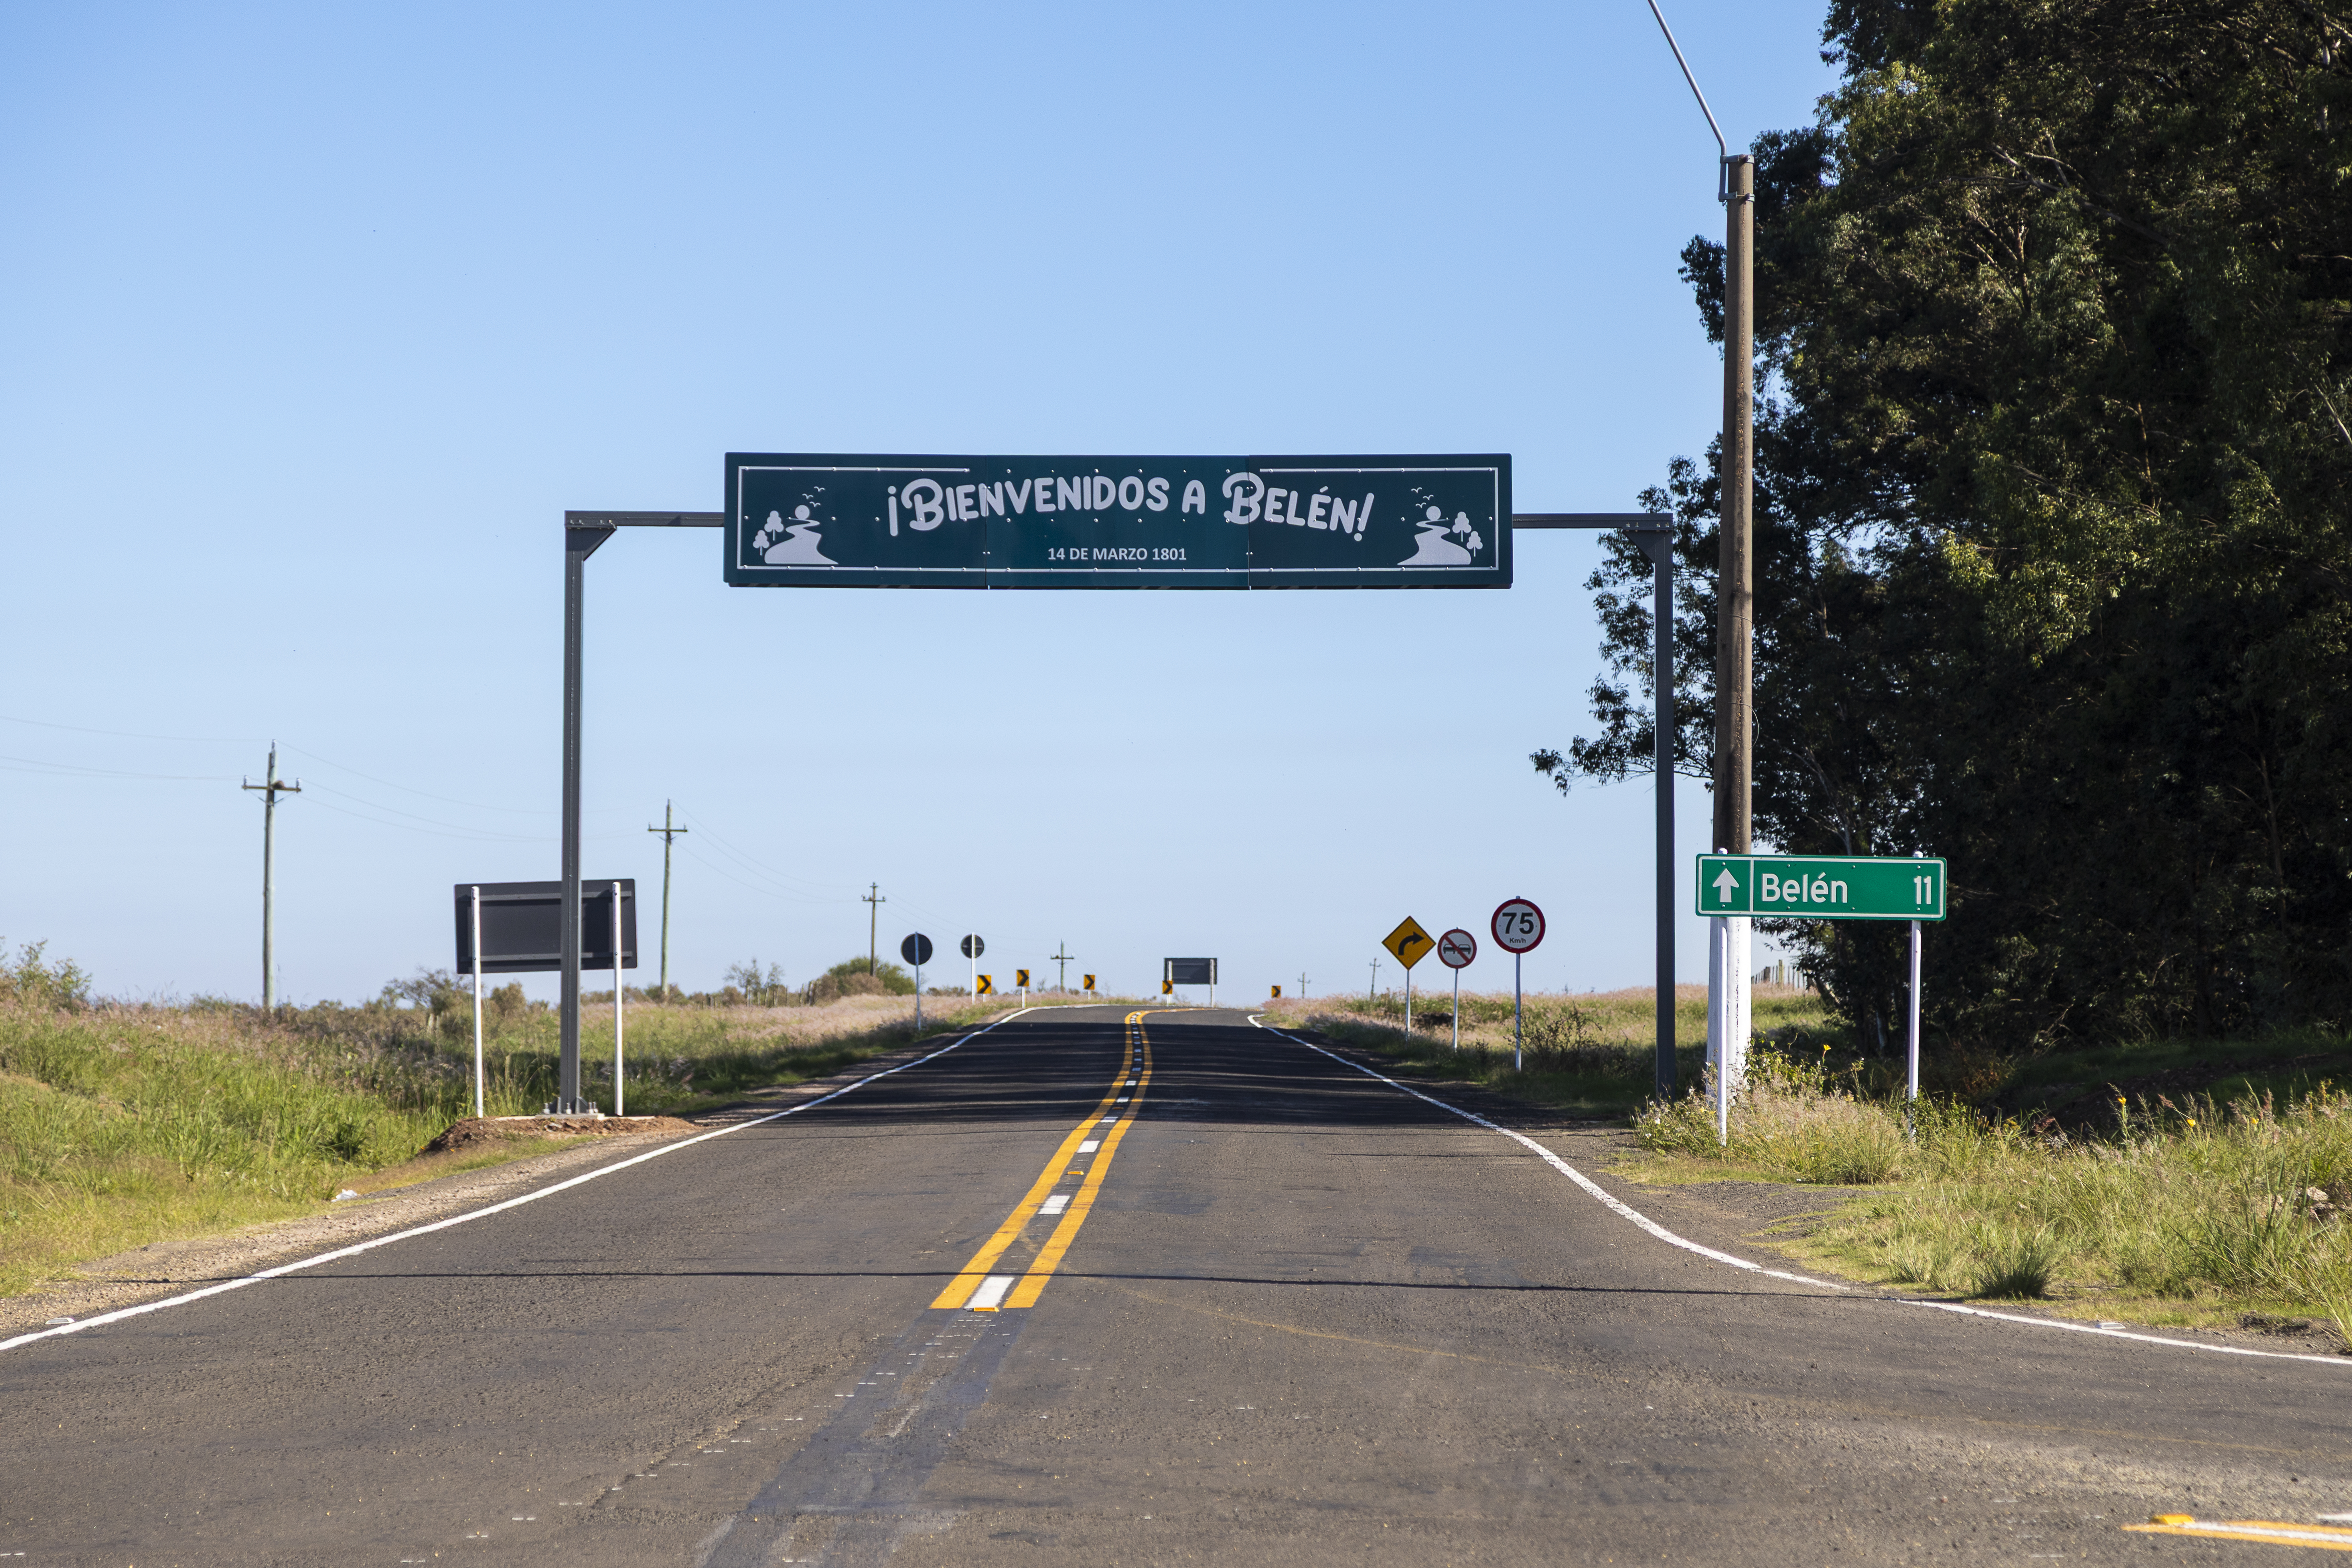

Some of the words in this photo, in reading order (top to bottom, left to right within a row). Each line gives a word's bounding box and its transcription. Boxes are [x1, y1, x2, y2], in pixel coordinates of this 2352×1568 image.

[888, 476, 1170, 536] ¡BIENVENIDOS
[1182, 479, 1206, 514] A
[1222, 472, 1374, 542] BELÉN!
[1048, 548, 1065, 560] 14
[1070, 548, 1088, 560] DE
[1093, 548, 1147, 560] MARZO
[1152, 548, 1186, 560] 1801
[1762, 872, 1848, 903] Belén
[1914, 876, 1932, 905] 11
[1502, 912, 1534, 935] 75
